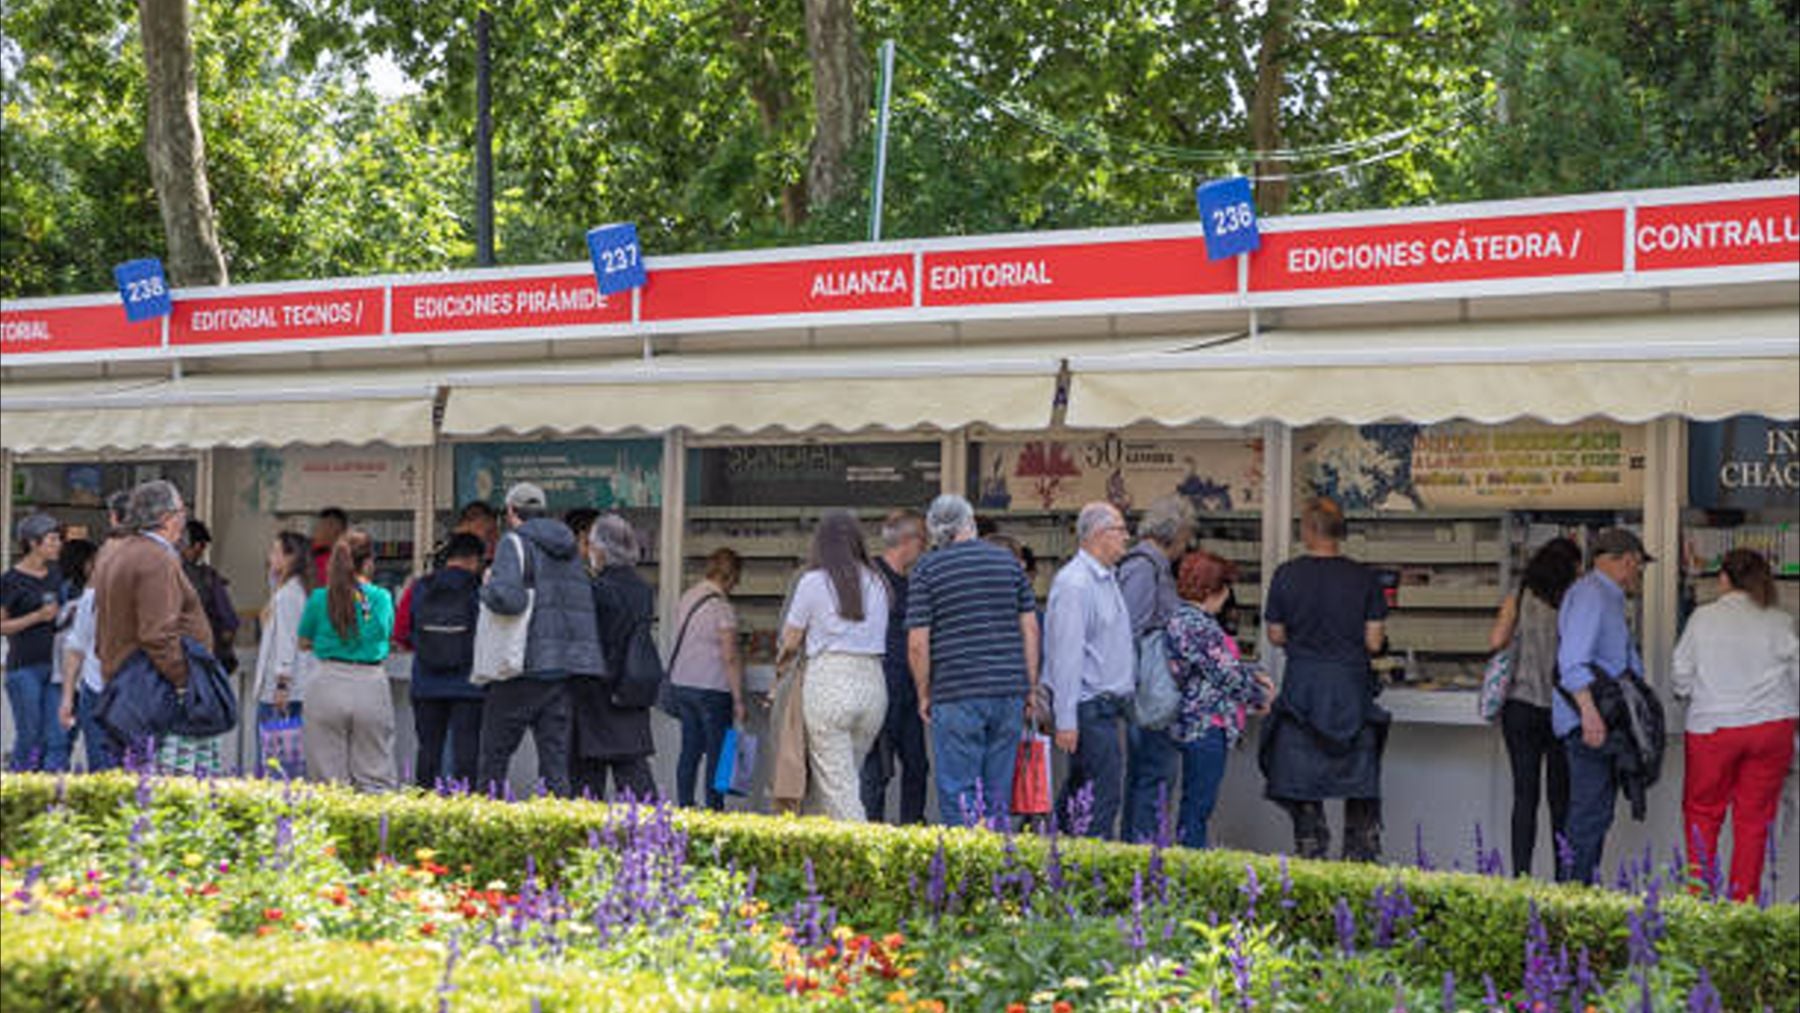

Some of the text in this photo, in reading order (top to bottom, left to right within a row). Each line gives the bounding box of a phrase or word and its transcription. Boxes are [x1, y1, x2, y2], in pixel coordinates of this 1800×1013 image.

[1213, 203, 1252, 235] 236
[602, 243, 637, 273] 237
[1288, 241, 1426, 272] EDICIONES
[1432, 229, 1563, 263] CÁTEDRA
[128, 276, 165, 302] 238
[810, 260, 1052, 297] ALIANZA EDITORIAL
[191, 306, 278, 331] EDITORIAL
[282, 302, 353, 326] TECNOS
[413, 293, 514, 319] EDICIONES
